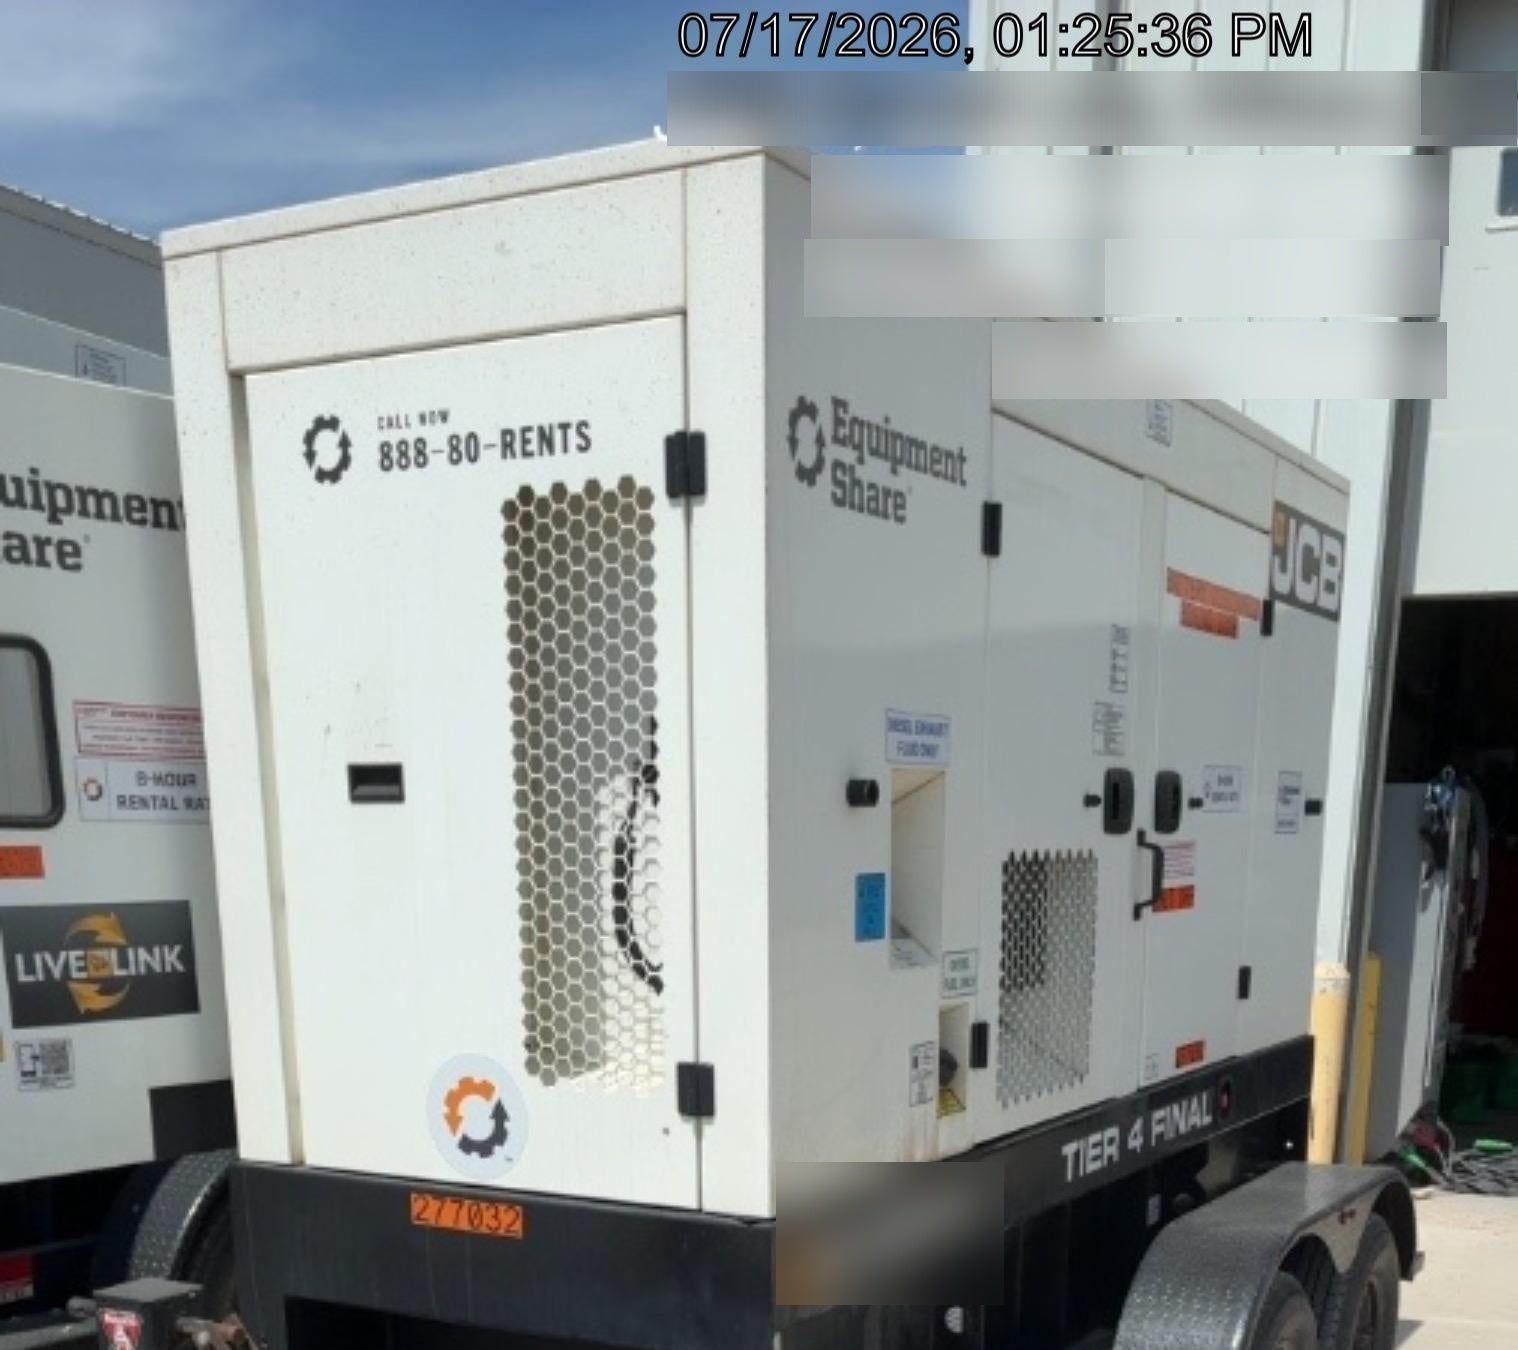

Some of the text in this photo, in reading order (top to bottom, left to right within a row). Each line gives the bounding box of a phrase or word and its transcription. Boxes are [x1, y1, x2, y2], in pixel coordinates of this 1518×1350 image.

[377, 409, 449, 431] CALL NOW
[379, 420, 592, 472] 888-80-RENTS
[830, 395, 967, 487] Equipment
[831, 458, 907, 525] Share
[1272, 518, 1342, 612] JCB
[116, 794, 179, 811] RENTAL
[14, 944, 185, 982] LIVE LINK
[1061, 1091, 1213, 1183] TIER 4 FINAL
[414, 1195, 520, 1234] 277032
